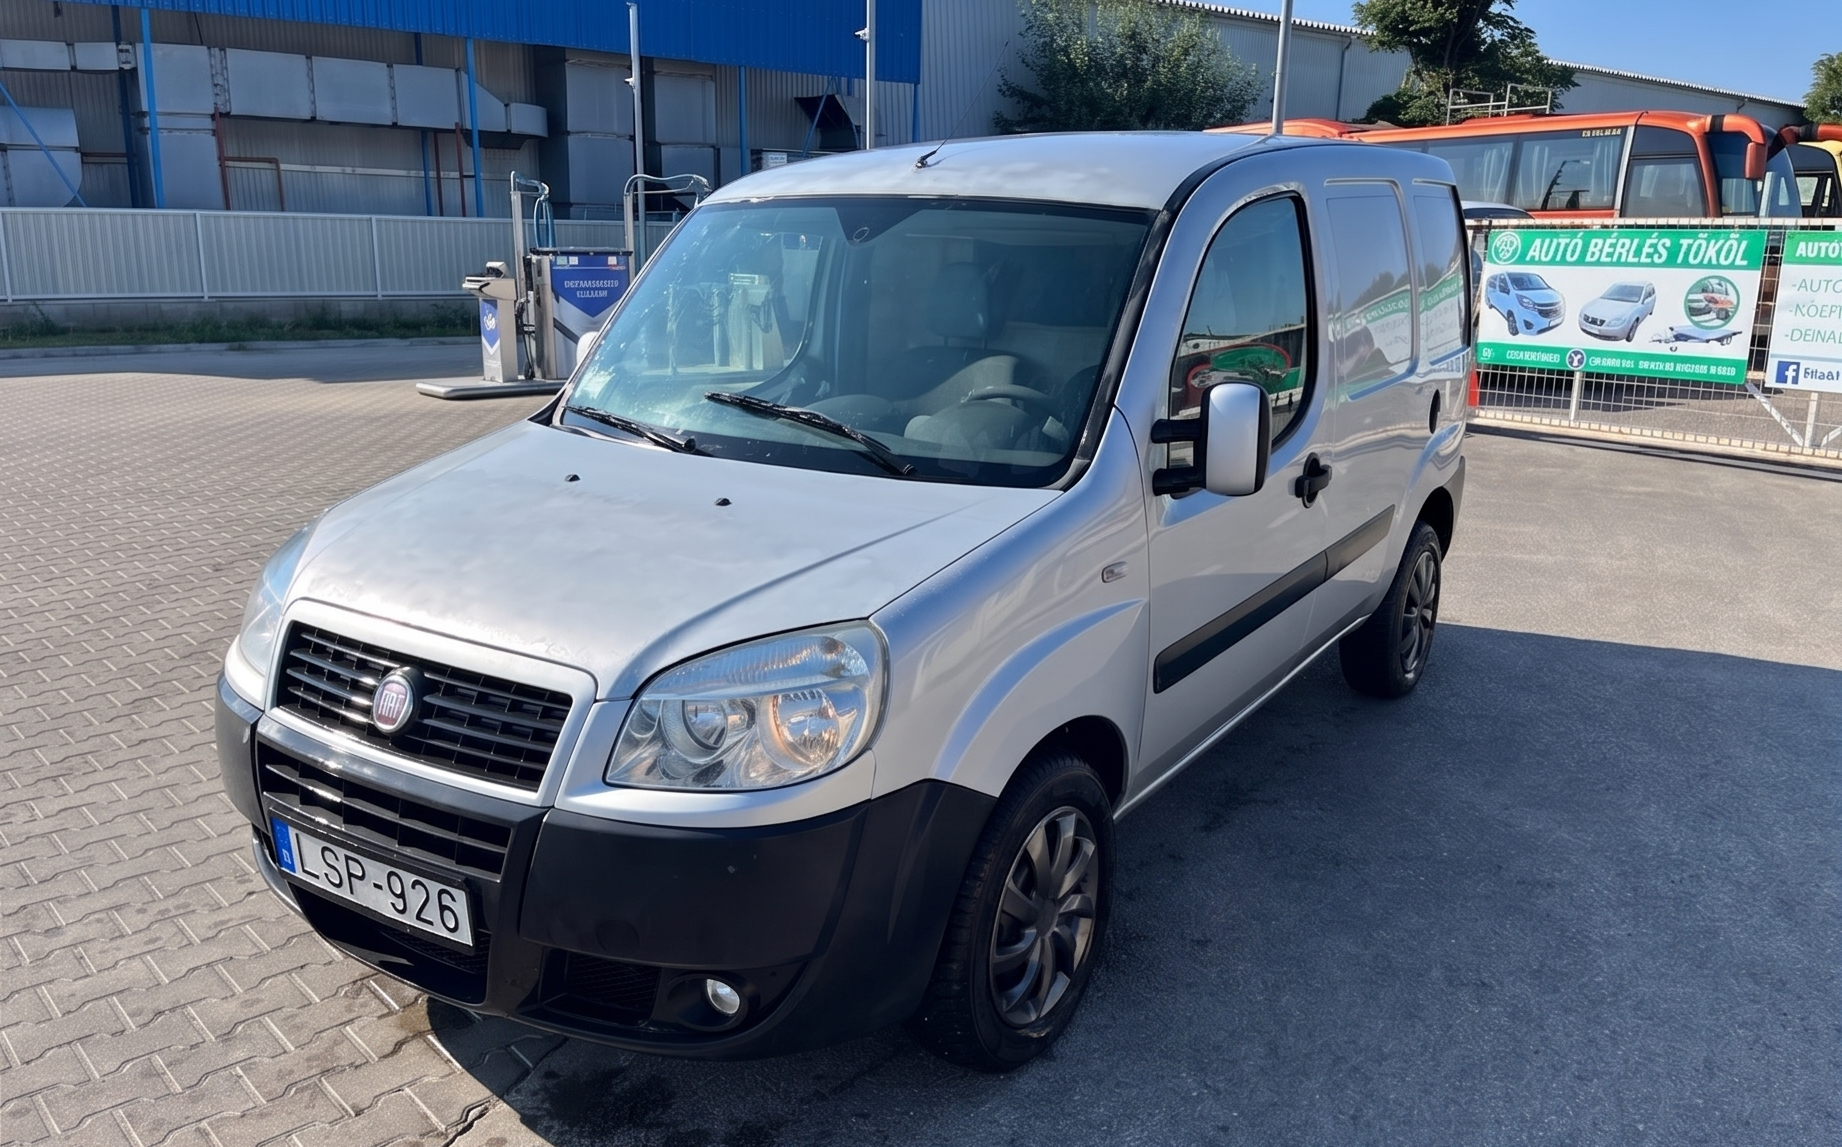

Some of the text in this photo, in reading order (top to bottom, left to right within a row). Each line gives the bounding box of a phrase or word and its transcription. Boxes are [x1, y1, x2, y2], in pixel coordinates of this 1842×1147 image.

[1525, 232, 1584, 262] AUTÓ
[1585, 232, 1671, 264] BÉRLÉS
[1795, 240, 1842, 258] AUTÓ
[378, 689, 406, 719] FIAT
[295, 832, 460, 934] LSP-926
